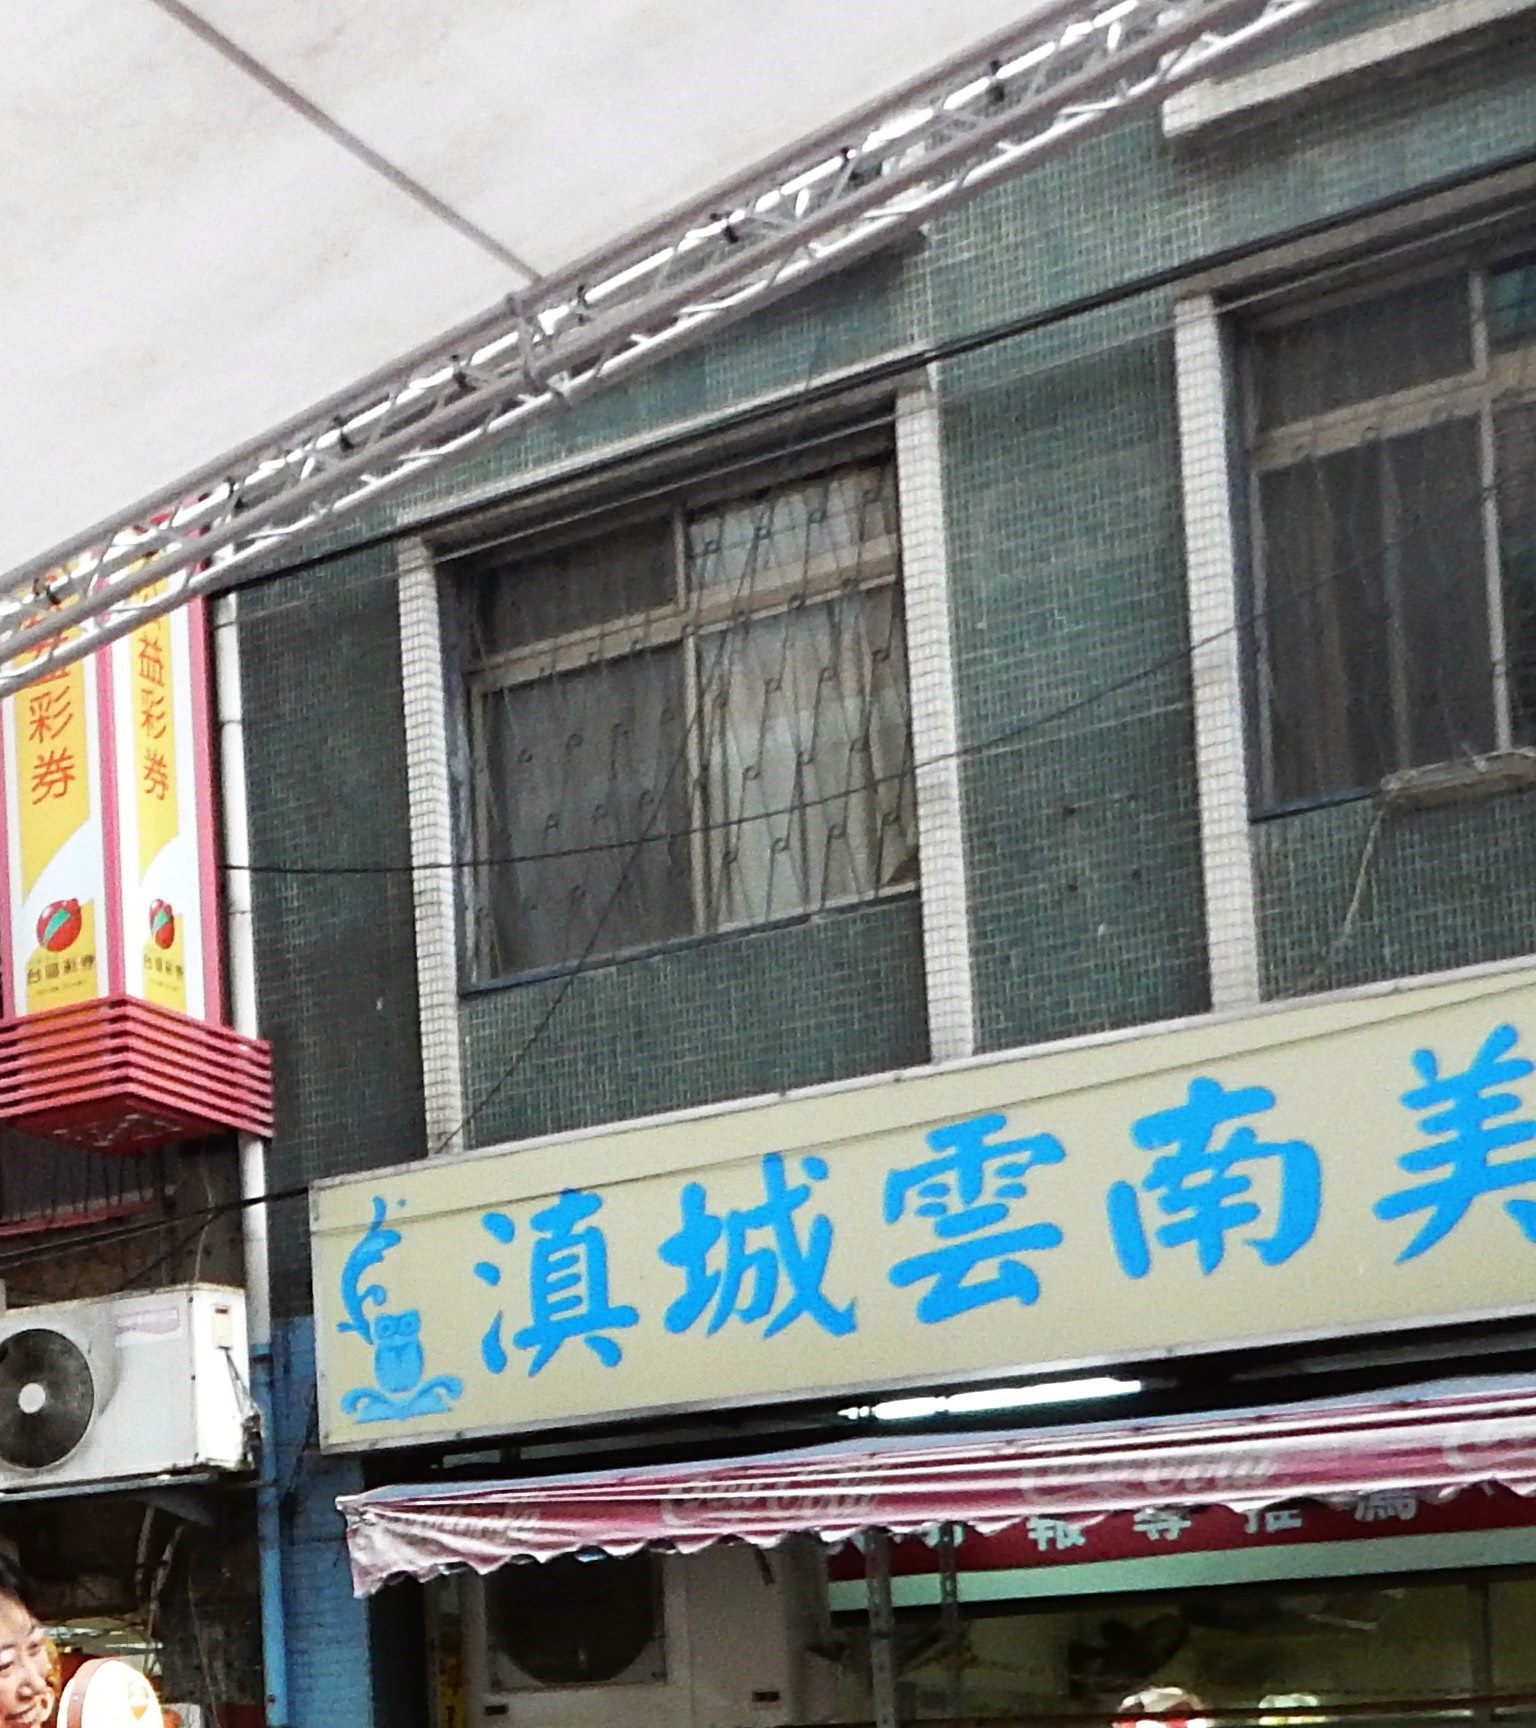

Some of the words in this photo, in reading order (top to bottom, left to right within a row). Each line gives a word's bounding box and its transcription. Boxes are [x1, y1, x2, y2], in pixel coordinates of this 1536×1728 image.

[474, 1024, 1536, 1376] 滇城雲南美
